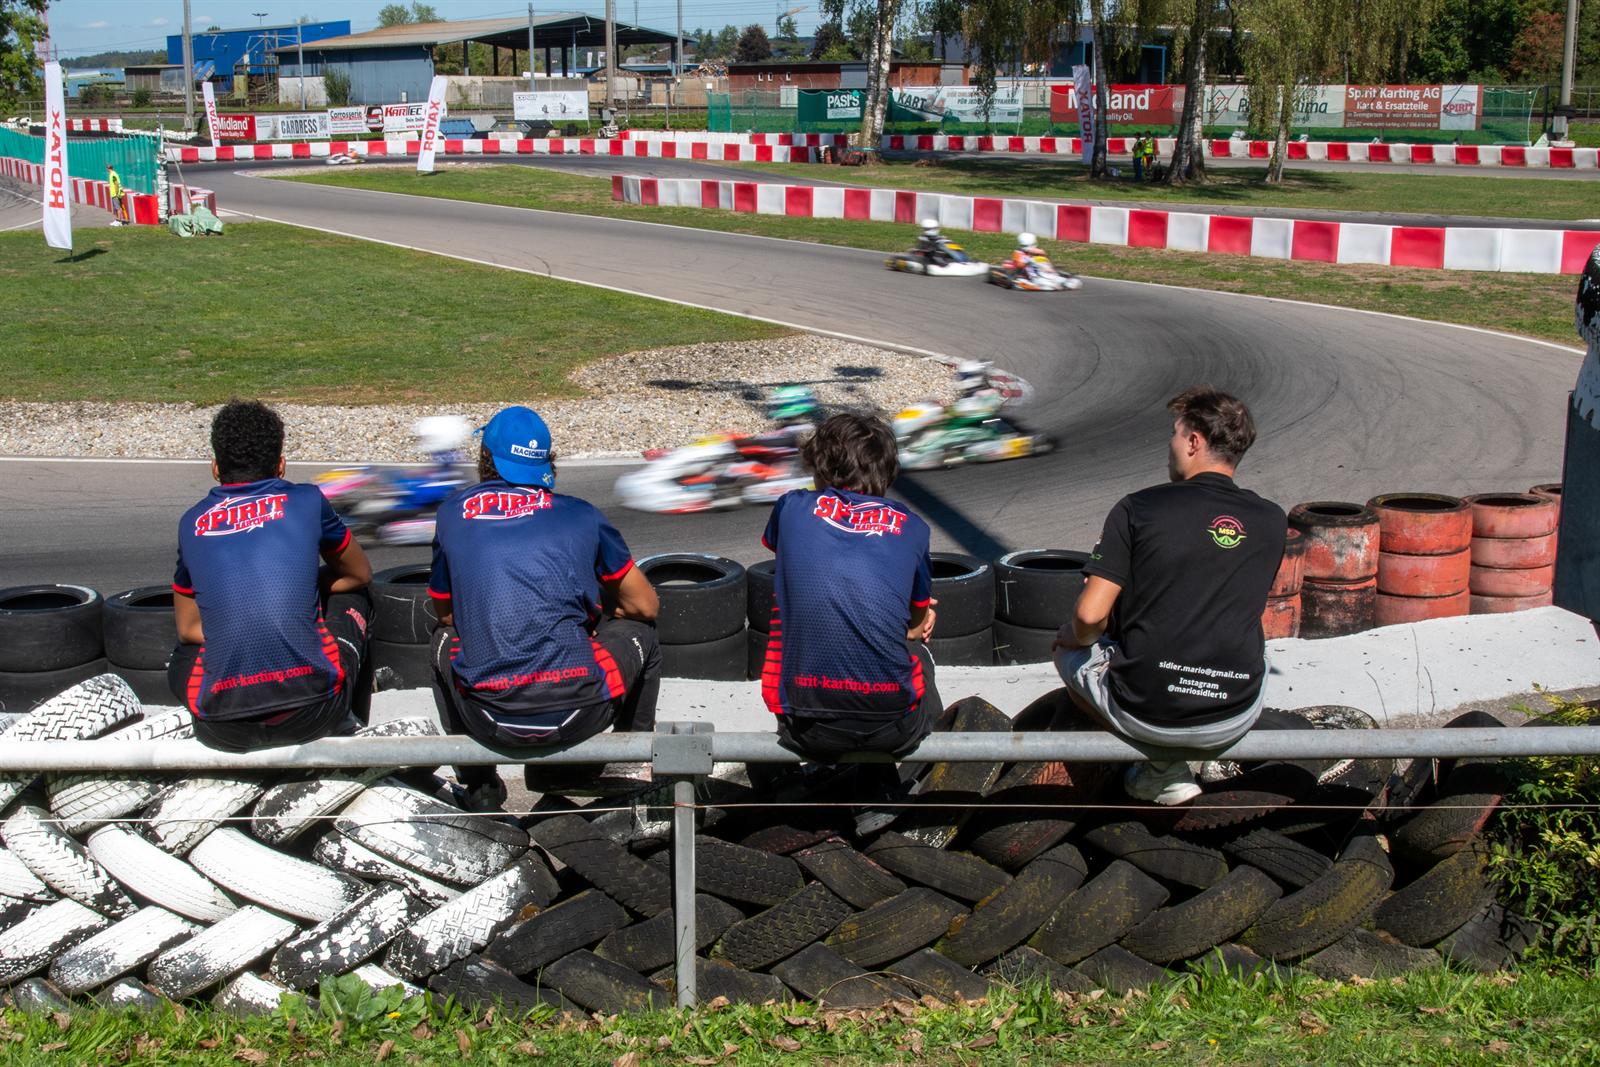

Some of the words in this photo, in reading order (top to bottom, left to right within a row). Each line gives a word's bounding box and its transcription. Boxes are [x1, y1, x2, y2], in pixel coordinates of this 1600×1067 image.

[897, 92, 927, 110] KART
[1068, 88, 1149, 110] Mland
[1380, 87, 1419, 100] Karting
[1422, 88, 1440, 98] AG
[1375, 102, 1383, 110] &
[1385, 101, 1429, 110] Ersatzteile
[1442, 103, 1475, 113] SPIRIT
[207, 101, 219, 140] ROTAX
[217, 116, 248, 130] Midland
[281, 119, 318, 134] CARDRESS
[424, 99, 440, 151] ROTAX
[195, 494, 288, 536] SPIRIT
[813, 495, 908, 529] SPIRIT
[1218, 527, 1236, 535] MSD
[1159, 661, 1250, 680] sidler.mario@gmail.com
[1179, 677, 1219, 690] Instagram
[1167, 684, 1228, 700] @mariosidler10
